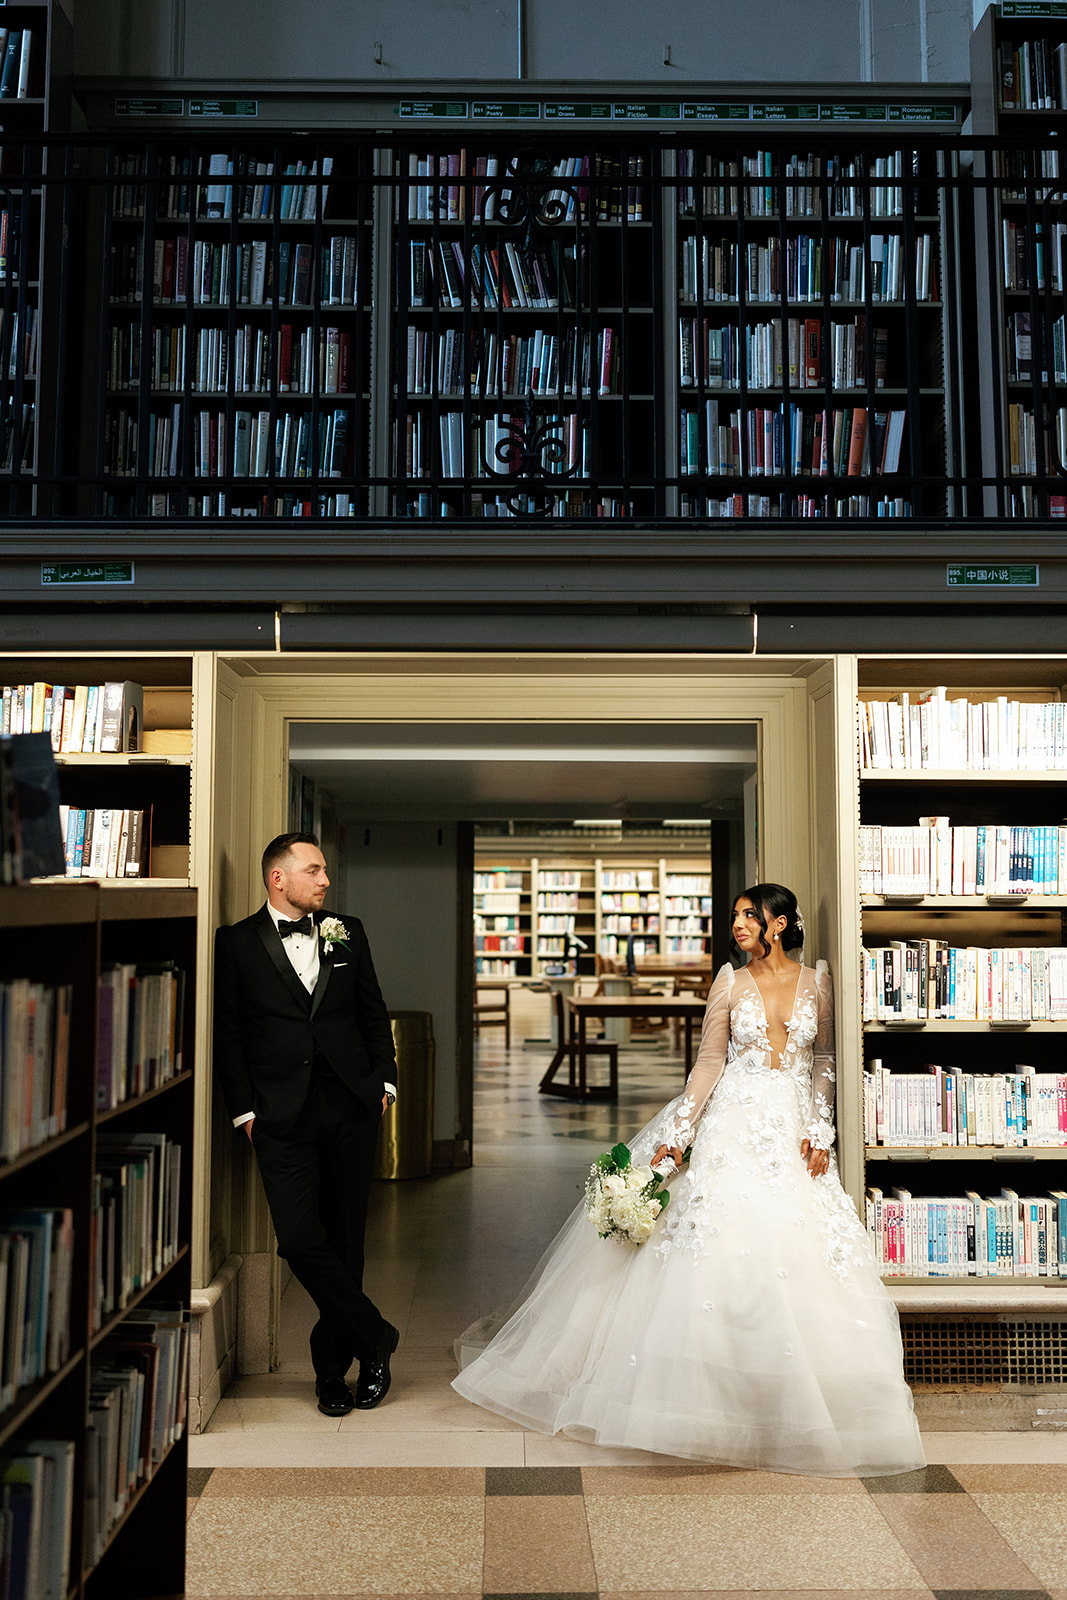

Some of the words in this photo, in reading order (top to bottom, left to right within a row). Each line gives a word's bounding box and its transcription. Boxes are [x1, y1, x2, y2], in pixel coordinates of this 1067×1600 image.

[255, 242, 264, 272] GENET
[60, 569, 81, 579] العربي
[84, 568, 103, 577] الخيال
[967, 570, 1009, 580] 中国小说
